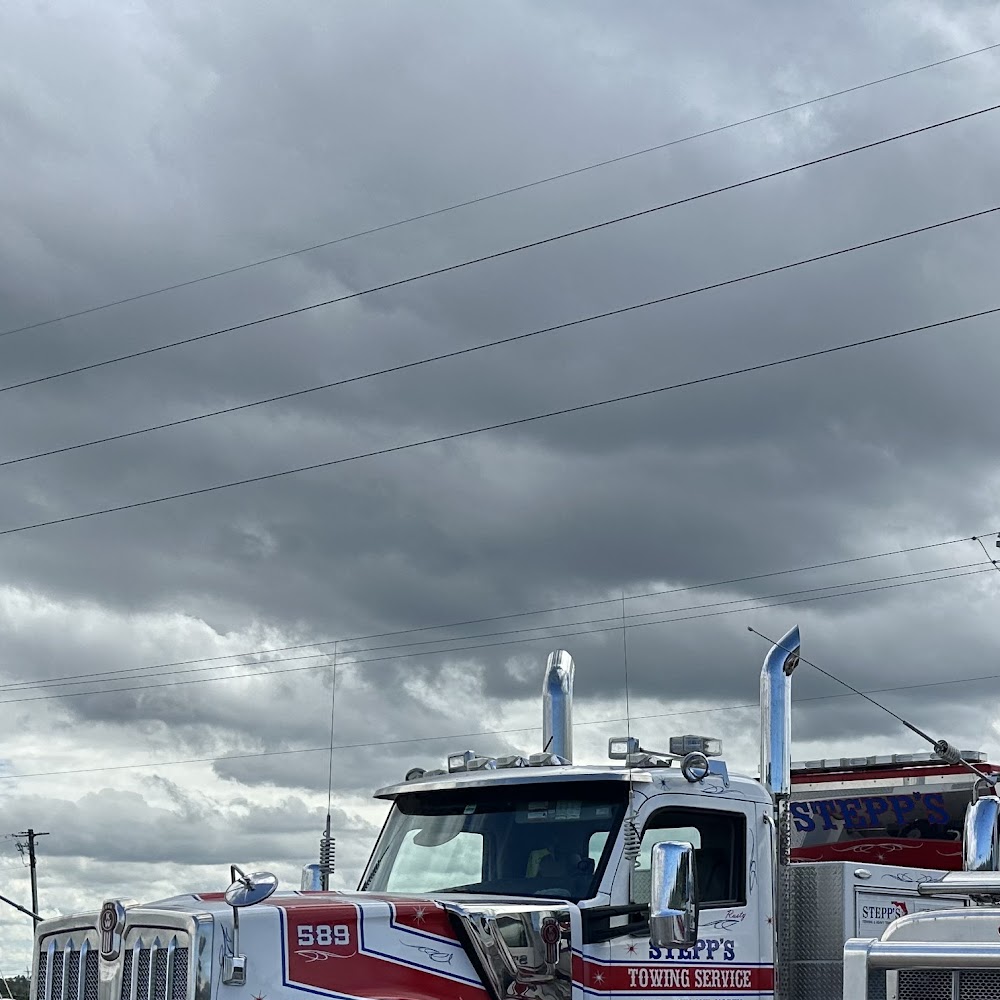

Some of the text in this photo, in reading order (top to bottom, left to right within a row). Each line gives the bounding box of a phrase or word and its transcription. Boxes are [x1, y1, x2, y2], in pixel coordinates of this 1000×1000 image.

[789, 791, 949, 832] STEPP'S
[862, 905, 900, 919] STEPP'S
[297, 924, 350, 946] 589
[628, 967, 752, 988] TOWING SERVICE
